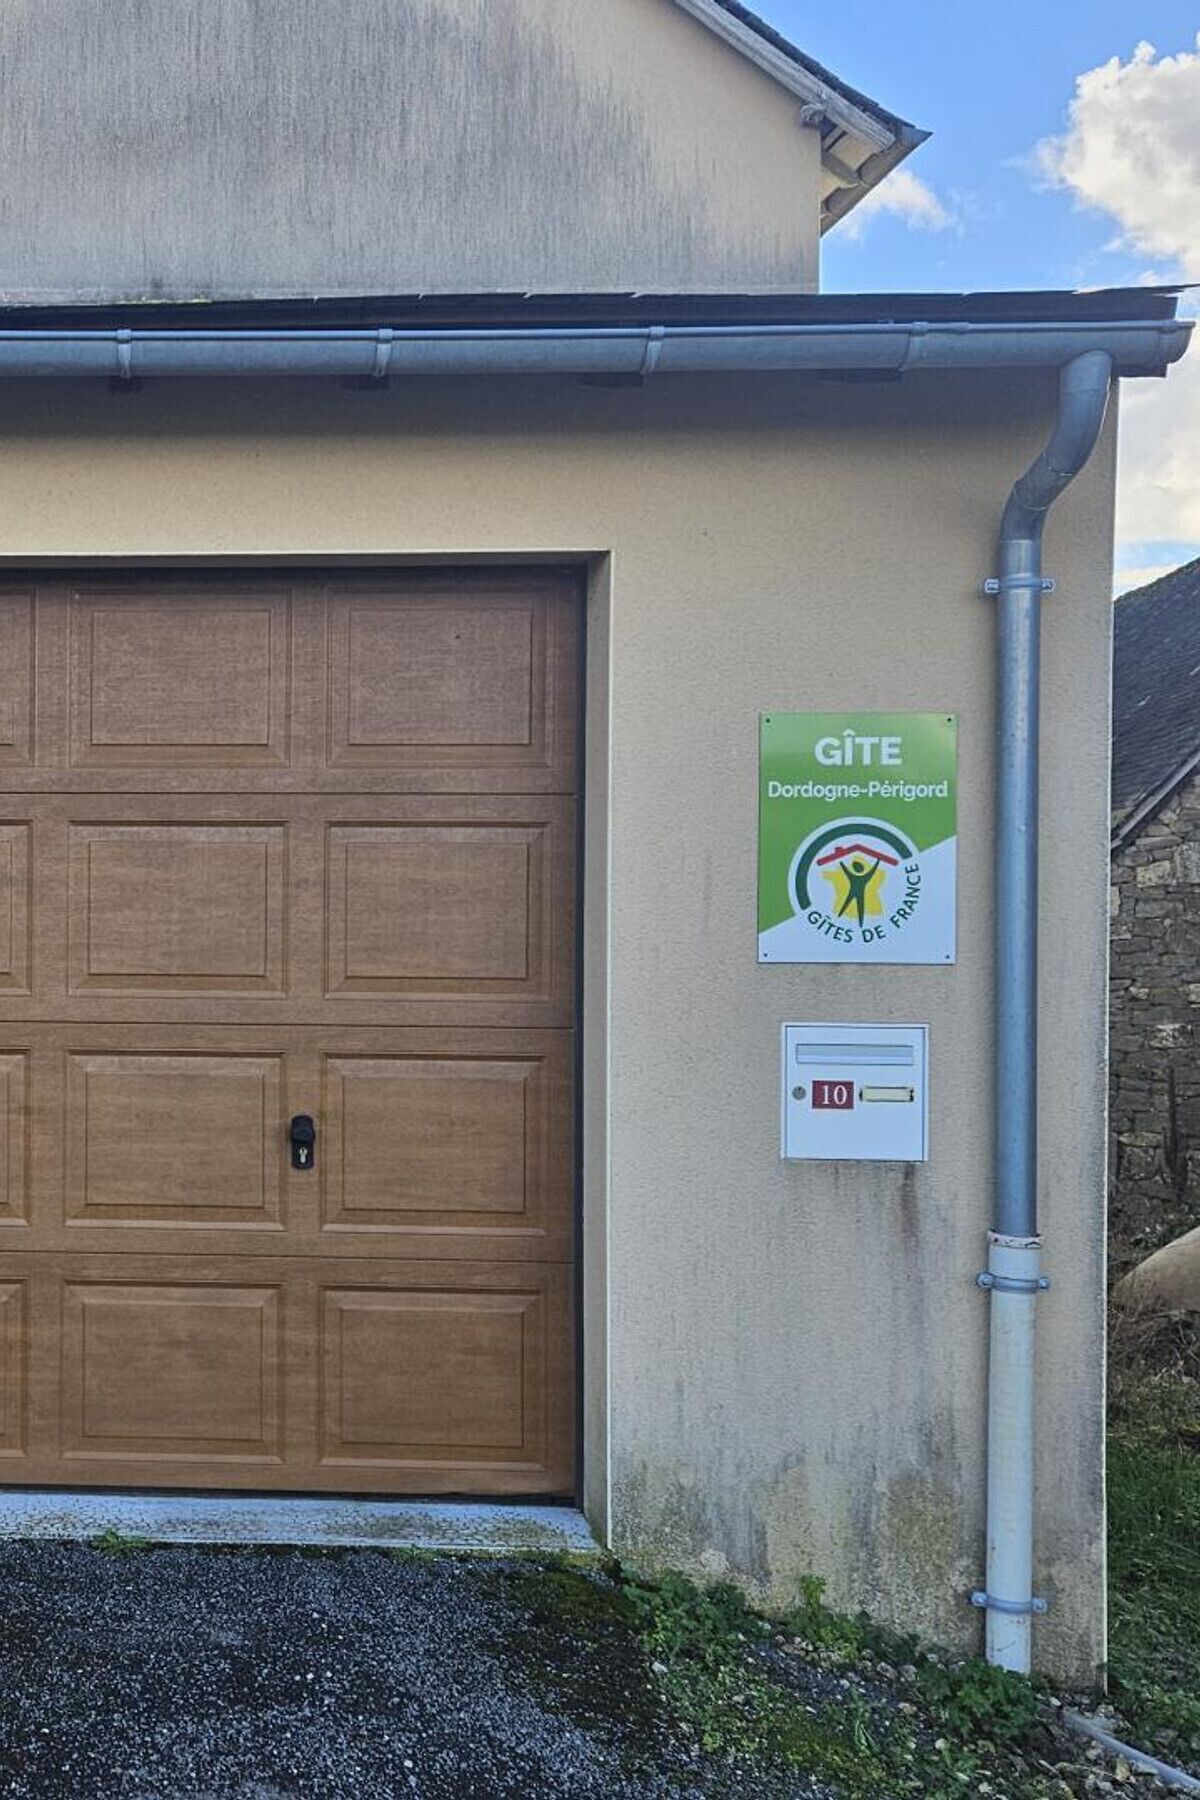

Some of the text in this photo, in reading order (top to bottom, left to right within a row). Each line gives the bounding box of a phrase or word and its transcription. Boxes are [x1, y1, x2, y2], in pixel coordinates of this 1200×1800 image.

[814, 729, 903, 766] GÎTE
[768, 780, 948, 801] Dordogne-Périgord
[807, 863, 921, 943] GÎTES DE FRANCE
[821, 1085, 848, 1105] 10
